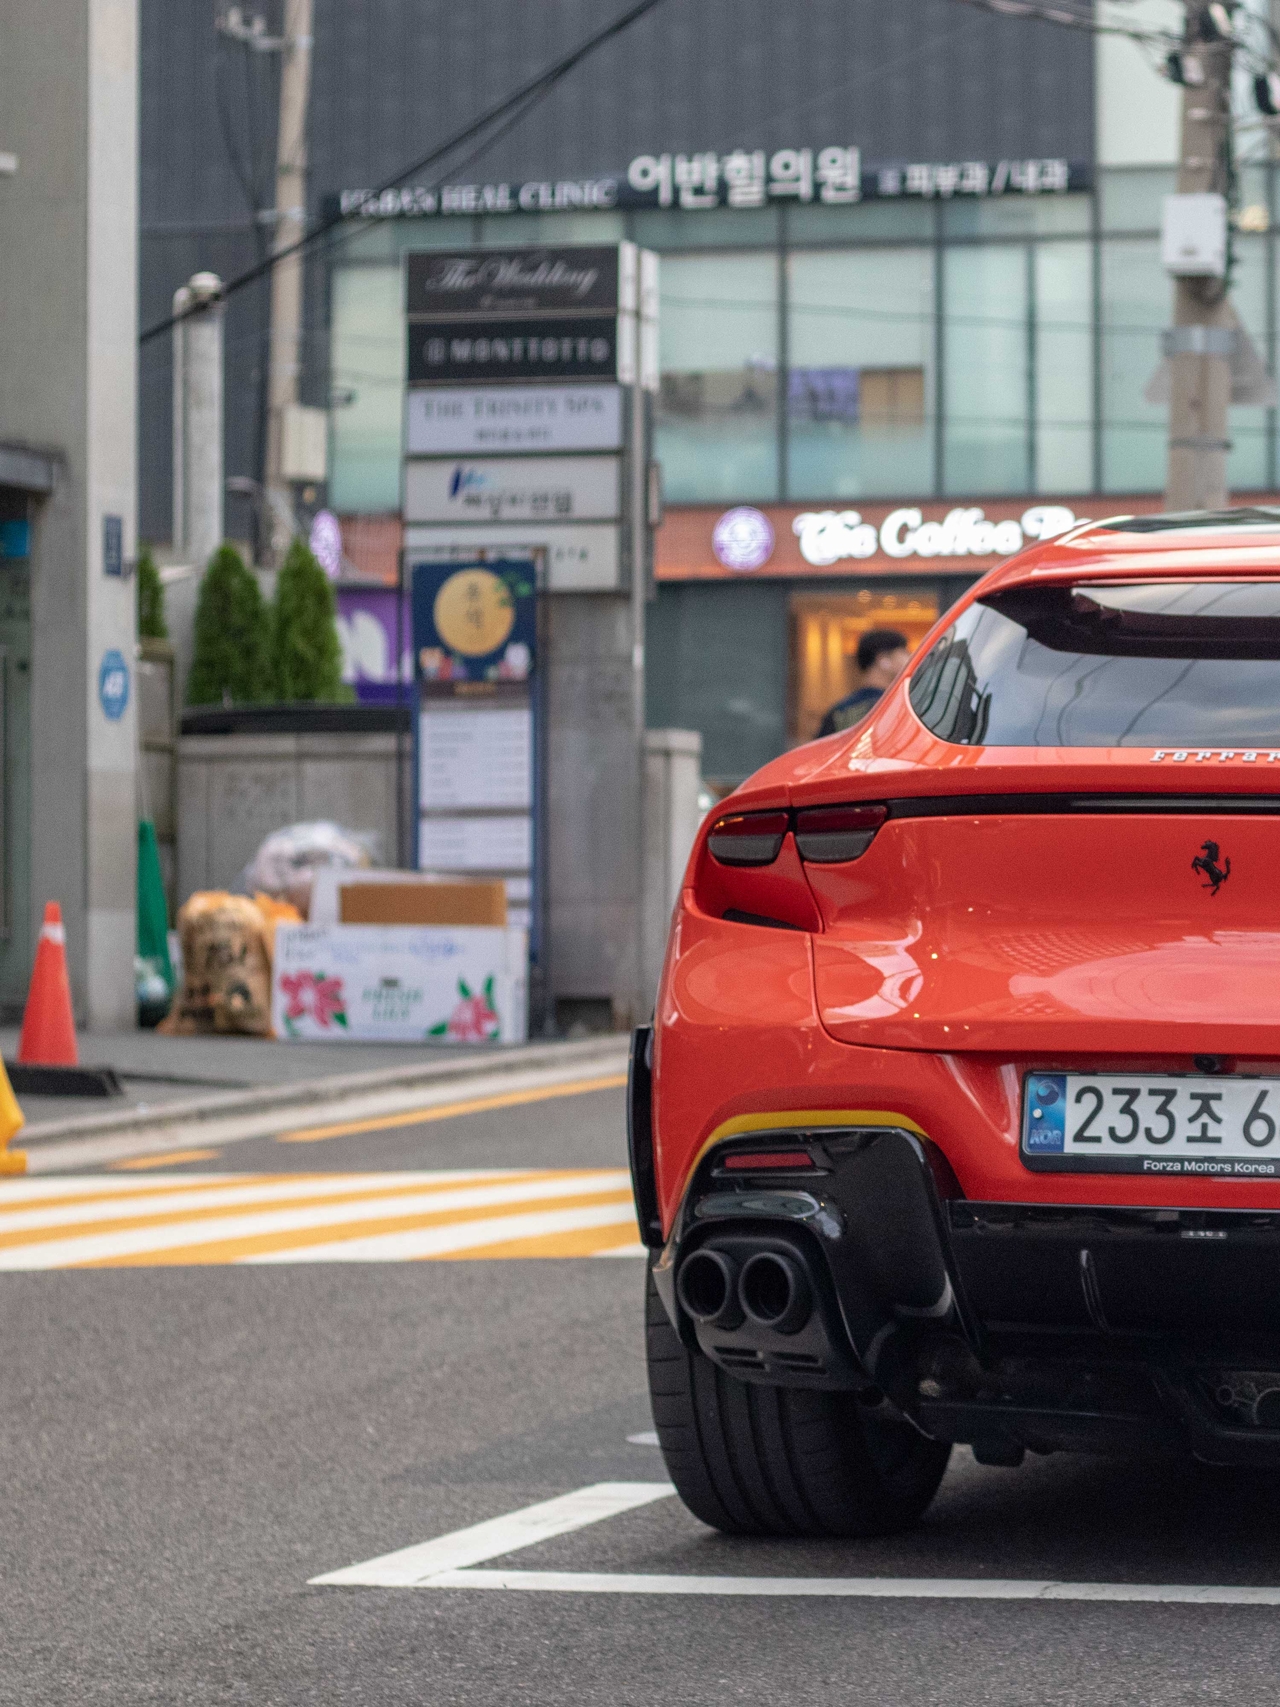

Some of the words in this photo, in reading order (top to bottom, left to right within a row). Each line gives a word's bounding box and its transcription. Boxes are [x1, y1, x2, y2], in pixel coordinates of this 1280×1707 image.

[518, 178, 619, 211] CLINIC
[627, 145, 861, 210] 어반힐의원
[879, 506, 1023, 559] Coffee
[1072, 1085, 1223, 1145] 233조
[1029, 1128, 1063, 1146] KOR
[1143, 1160, 1182, 1172] Forza
[1183, 1160, 1233, 1173] Motors
[1234, 1161, 1275, 1174] Korea
